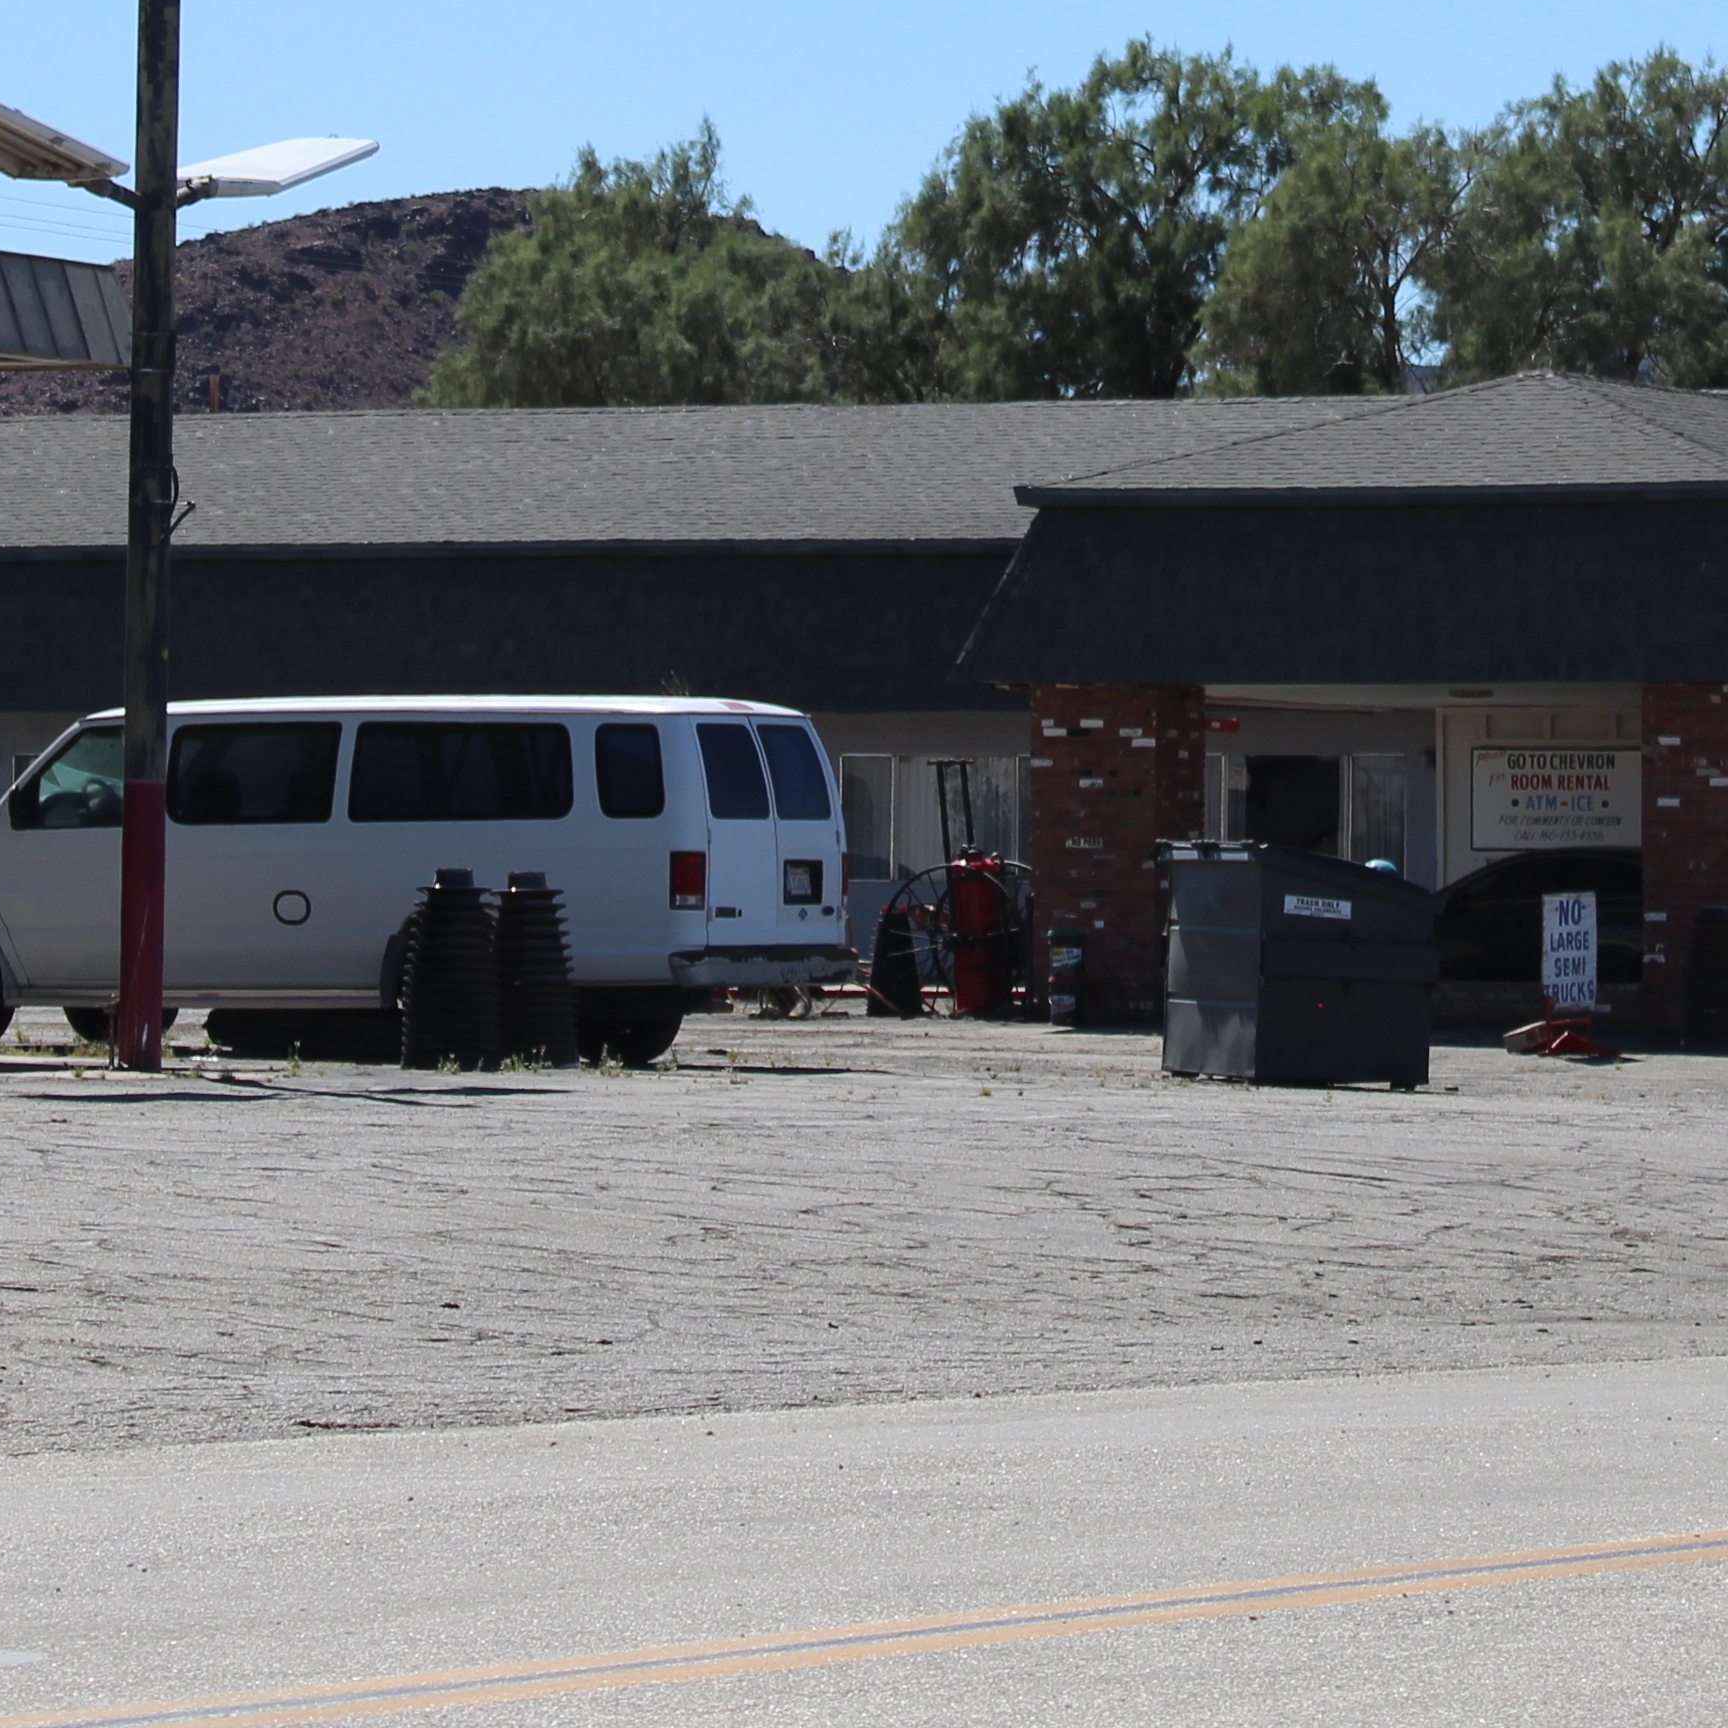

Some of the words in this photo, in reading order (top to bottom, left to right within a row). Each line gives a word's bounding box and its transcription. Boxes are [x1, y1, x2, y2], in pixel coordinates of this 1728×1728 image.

[1507, 753, 1526, 770] GO
[1529, 753, 1547, 770] TO
[1549, 753, 1615, 771] CHEVRON
[1511, 774, 1553, 791] ROOM
[1557, 774, 1611, 791] RENTAL
[1296, 898, 1319, 907] TRASH
[1321, 899, 1340, 909] ONLY
[1558, 898, 1582, 927] NO
[1550, 931, 1590, 953] LARGE
[1553, 956, 1586, 978] SEMI
[1543, 979, 1595, 1003] TRUCKS
